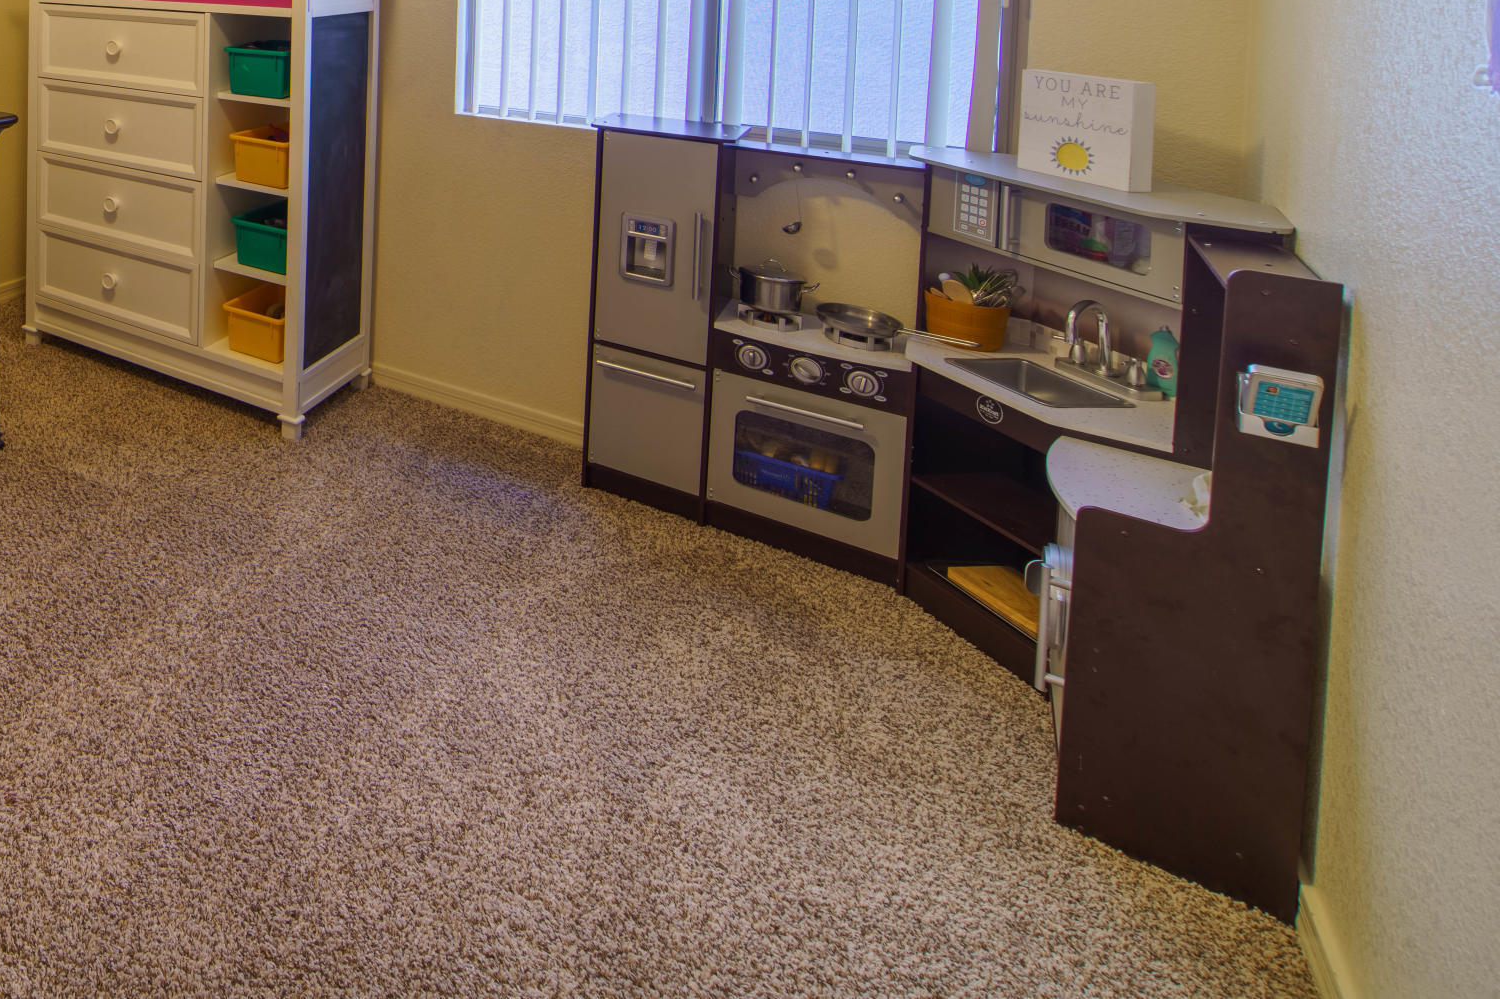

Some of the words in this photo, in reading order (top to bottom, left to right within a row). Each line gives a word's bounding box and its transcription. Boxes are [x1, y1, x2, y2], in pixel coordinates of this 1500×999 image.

[1034, 75, 1072, 93] YOU
[1080, 81, 1122, 100] ARE
[1060, 95, 1089, 110] MY
[1023, 111, 1129, 136] sunshine
